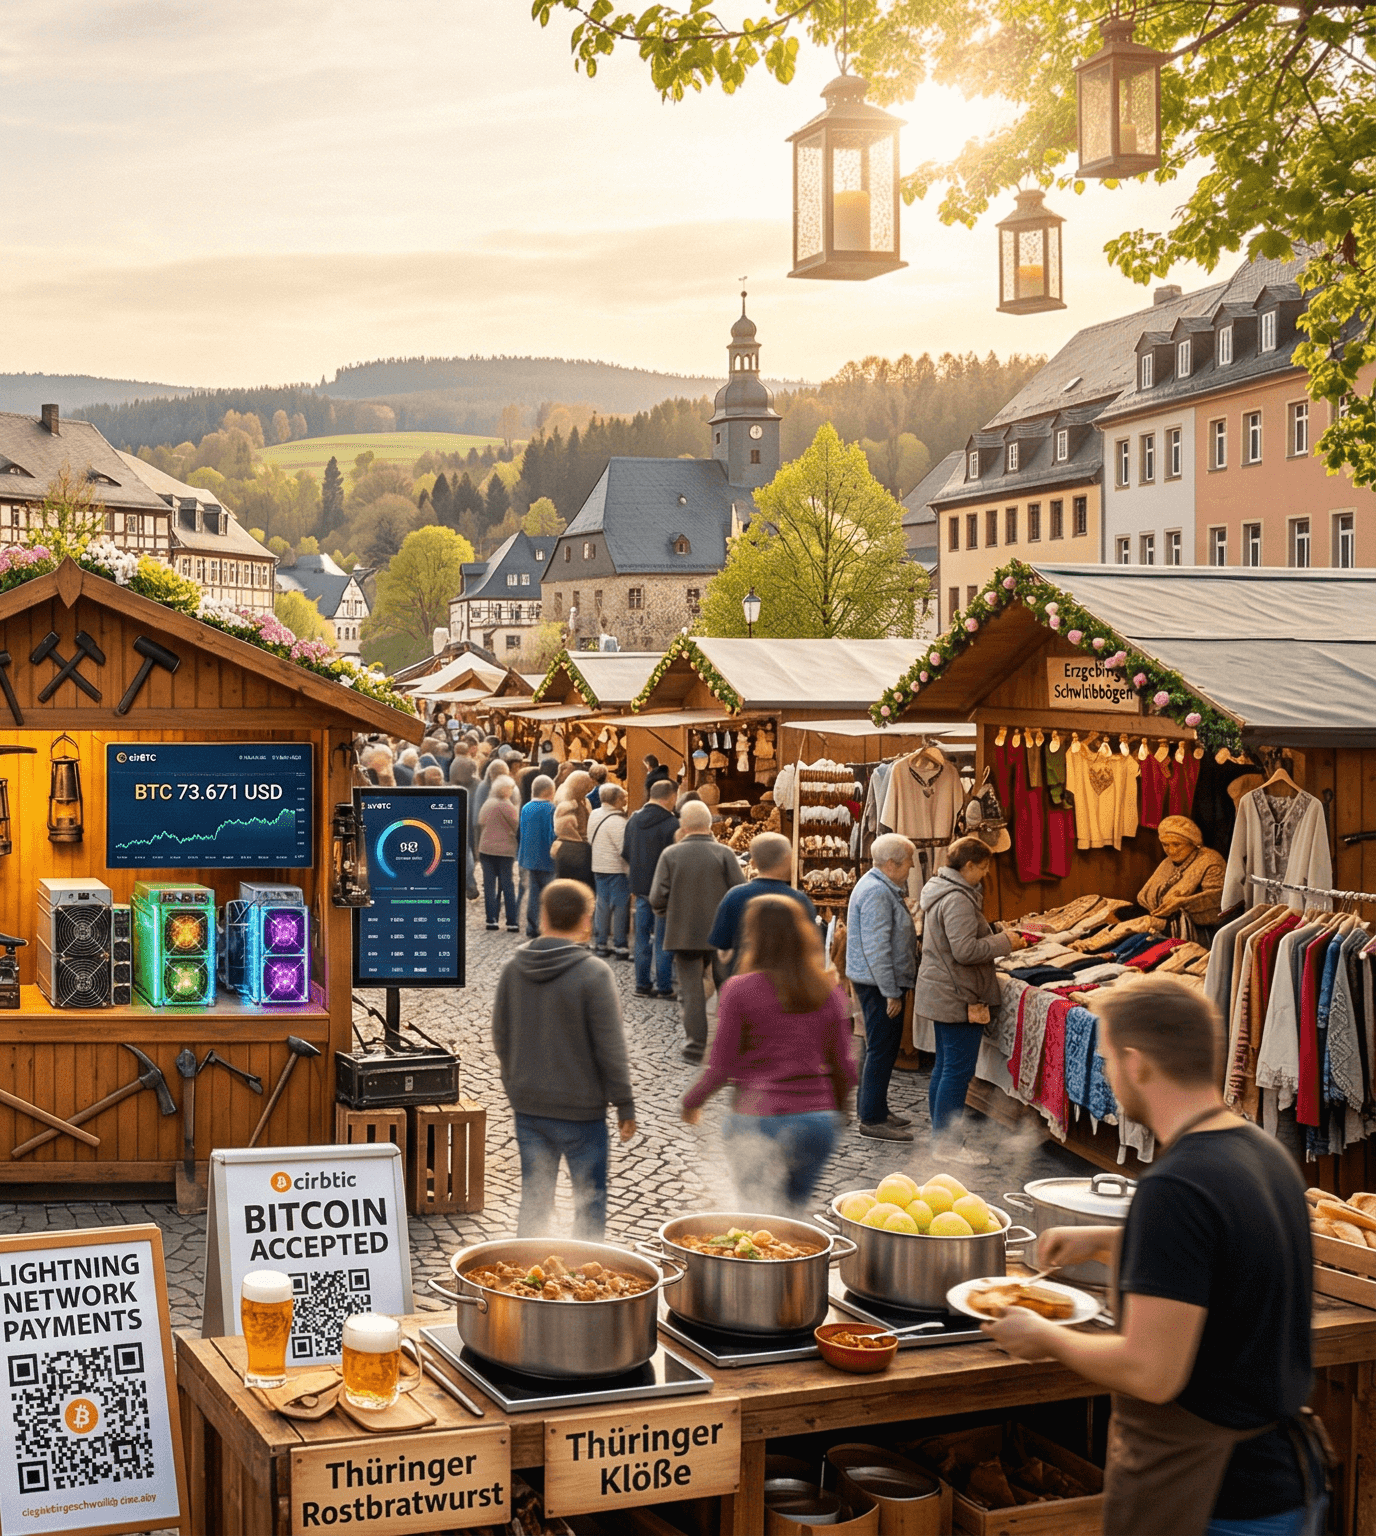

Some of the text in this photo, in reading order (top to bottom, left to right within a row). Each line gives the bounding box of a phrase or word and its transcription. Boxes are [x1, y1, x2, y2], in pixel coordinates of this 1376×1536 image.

[135, 784, 283, 800] BTC 73.671 USD
[293, 1171, 357, 1190] cirbtic
[244, 1197, 388, 1234] BITCOIN
[250, 1231, 389, 1262] ACCEPTED
[3, 1281, 138, 1315] NETWORK
[3, 1308, 143, 1343] PAYMENTS
[565, 1422, 724, 1462] Thüringer
[325, 1454, 477, 1489] Thüringer
[600, 1458, 692, 1496] Klöße
[302, 1482, 504, 1528] Rostbratwurst
